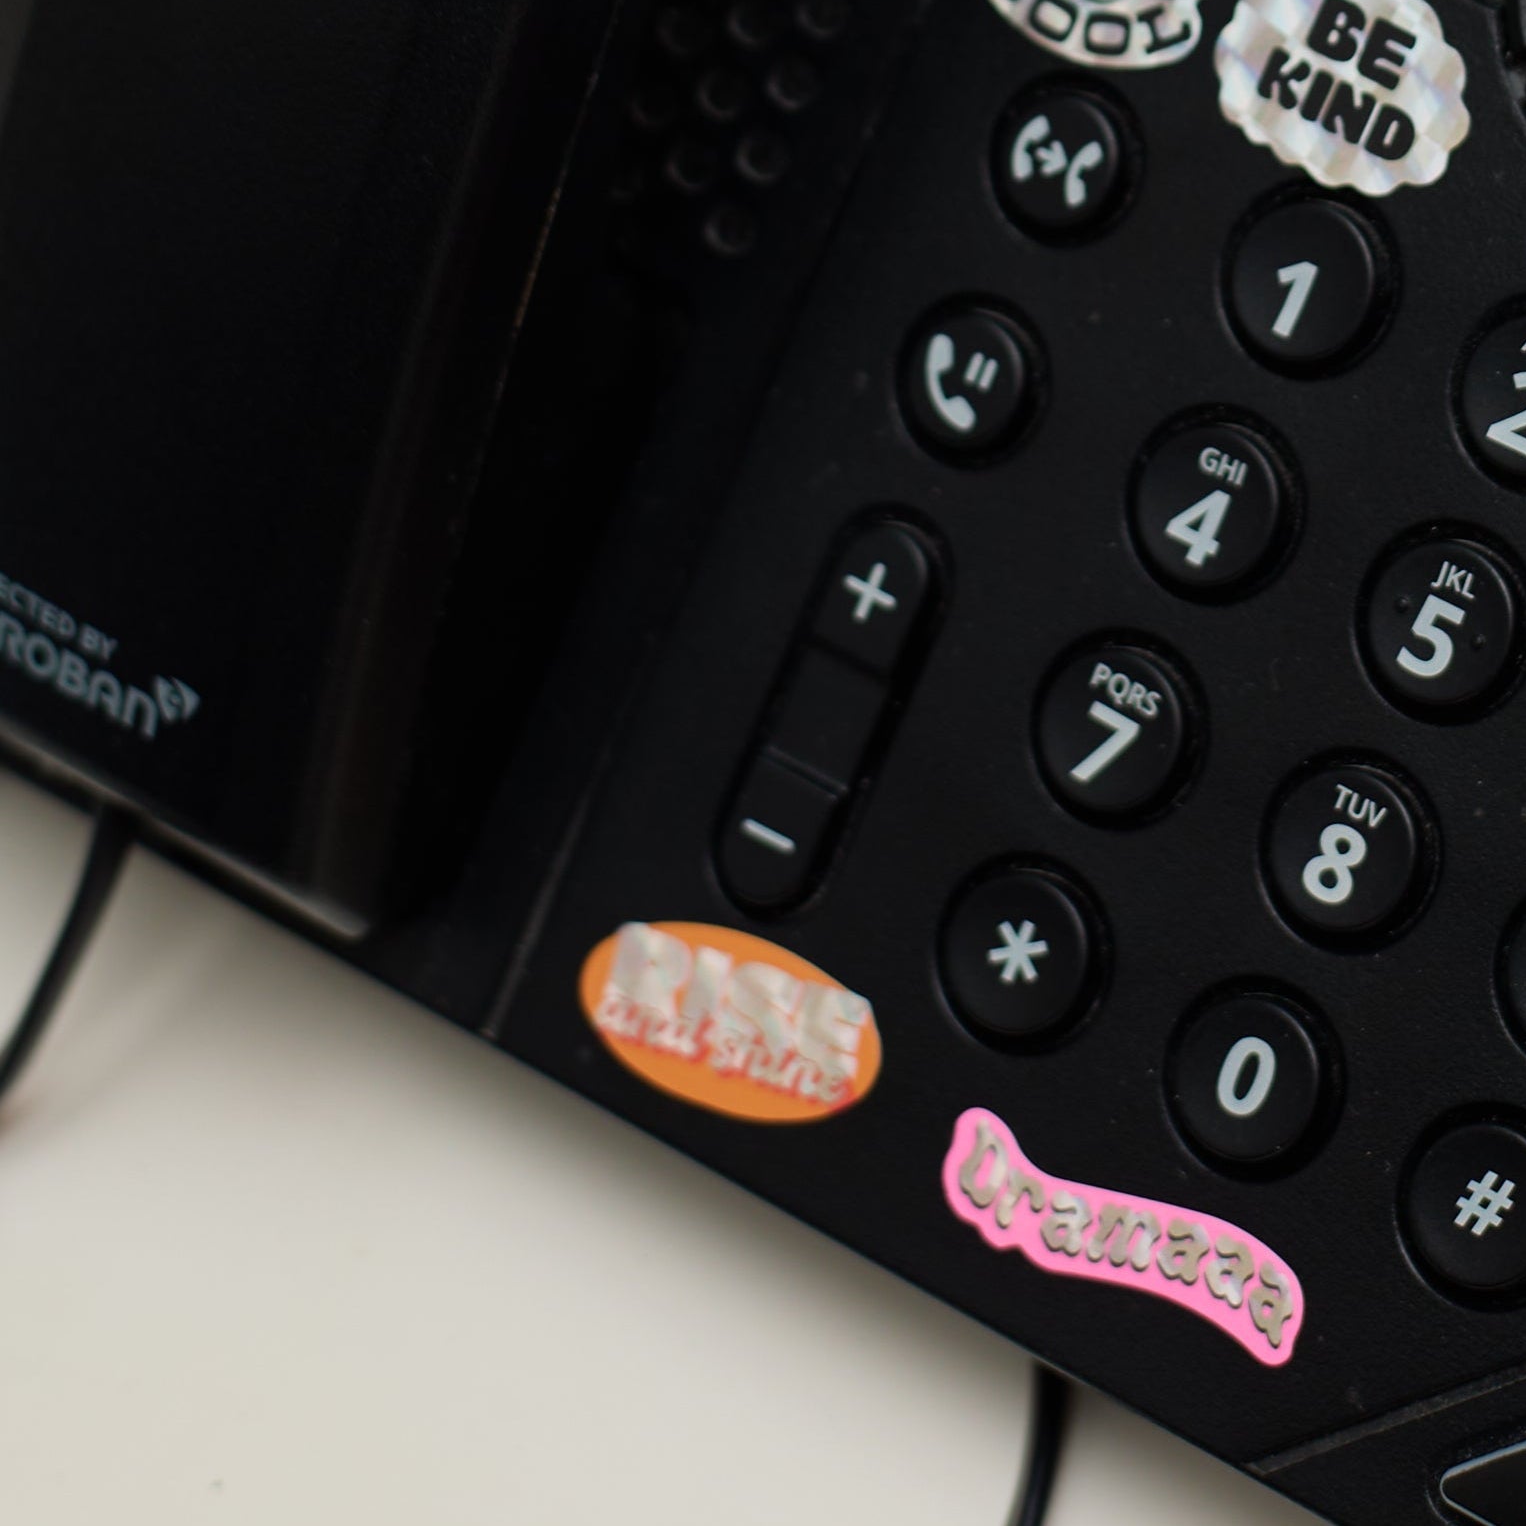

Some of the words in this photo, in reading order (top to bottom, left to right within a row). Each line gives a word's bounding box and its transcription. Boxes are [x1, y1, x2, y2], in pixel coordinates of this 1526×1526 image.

[1257, 45, 1416, 163] KIND
[1272, 260, 1318, 338] 1
[1199, 446, 1248, 488] GHI
[1165, 488, 1232, 567] 4
[1430, 561, 1477, 600] JKL
[79, 623, 119, 662] BY
[1395, 594, 1466, 678] 5
[1088, 662, 1162, 719] PQRS
[1069, 700, 1143, 783] 7
[1334, 783, 1388, 830] TUV
[1302, 823, 1368, 905] 8
[1216, 1036, 1277, 1117] 0
[957, 1118, 1294, 1350] Dramaaa
